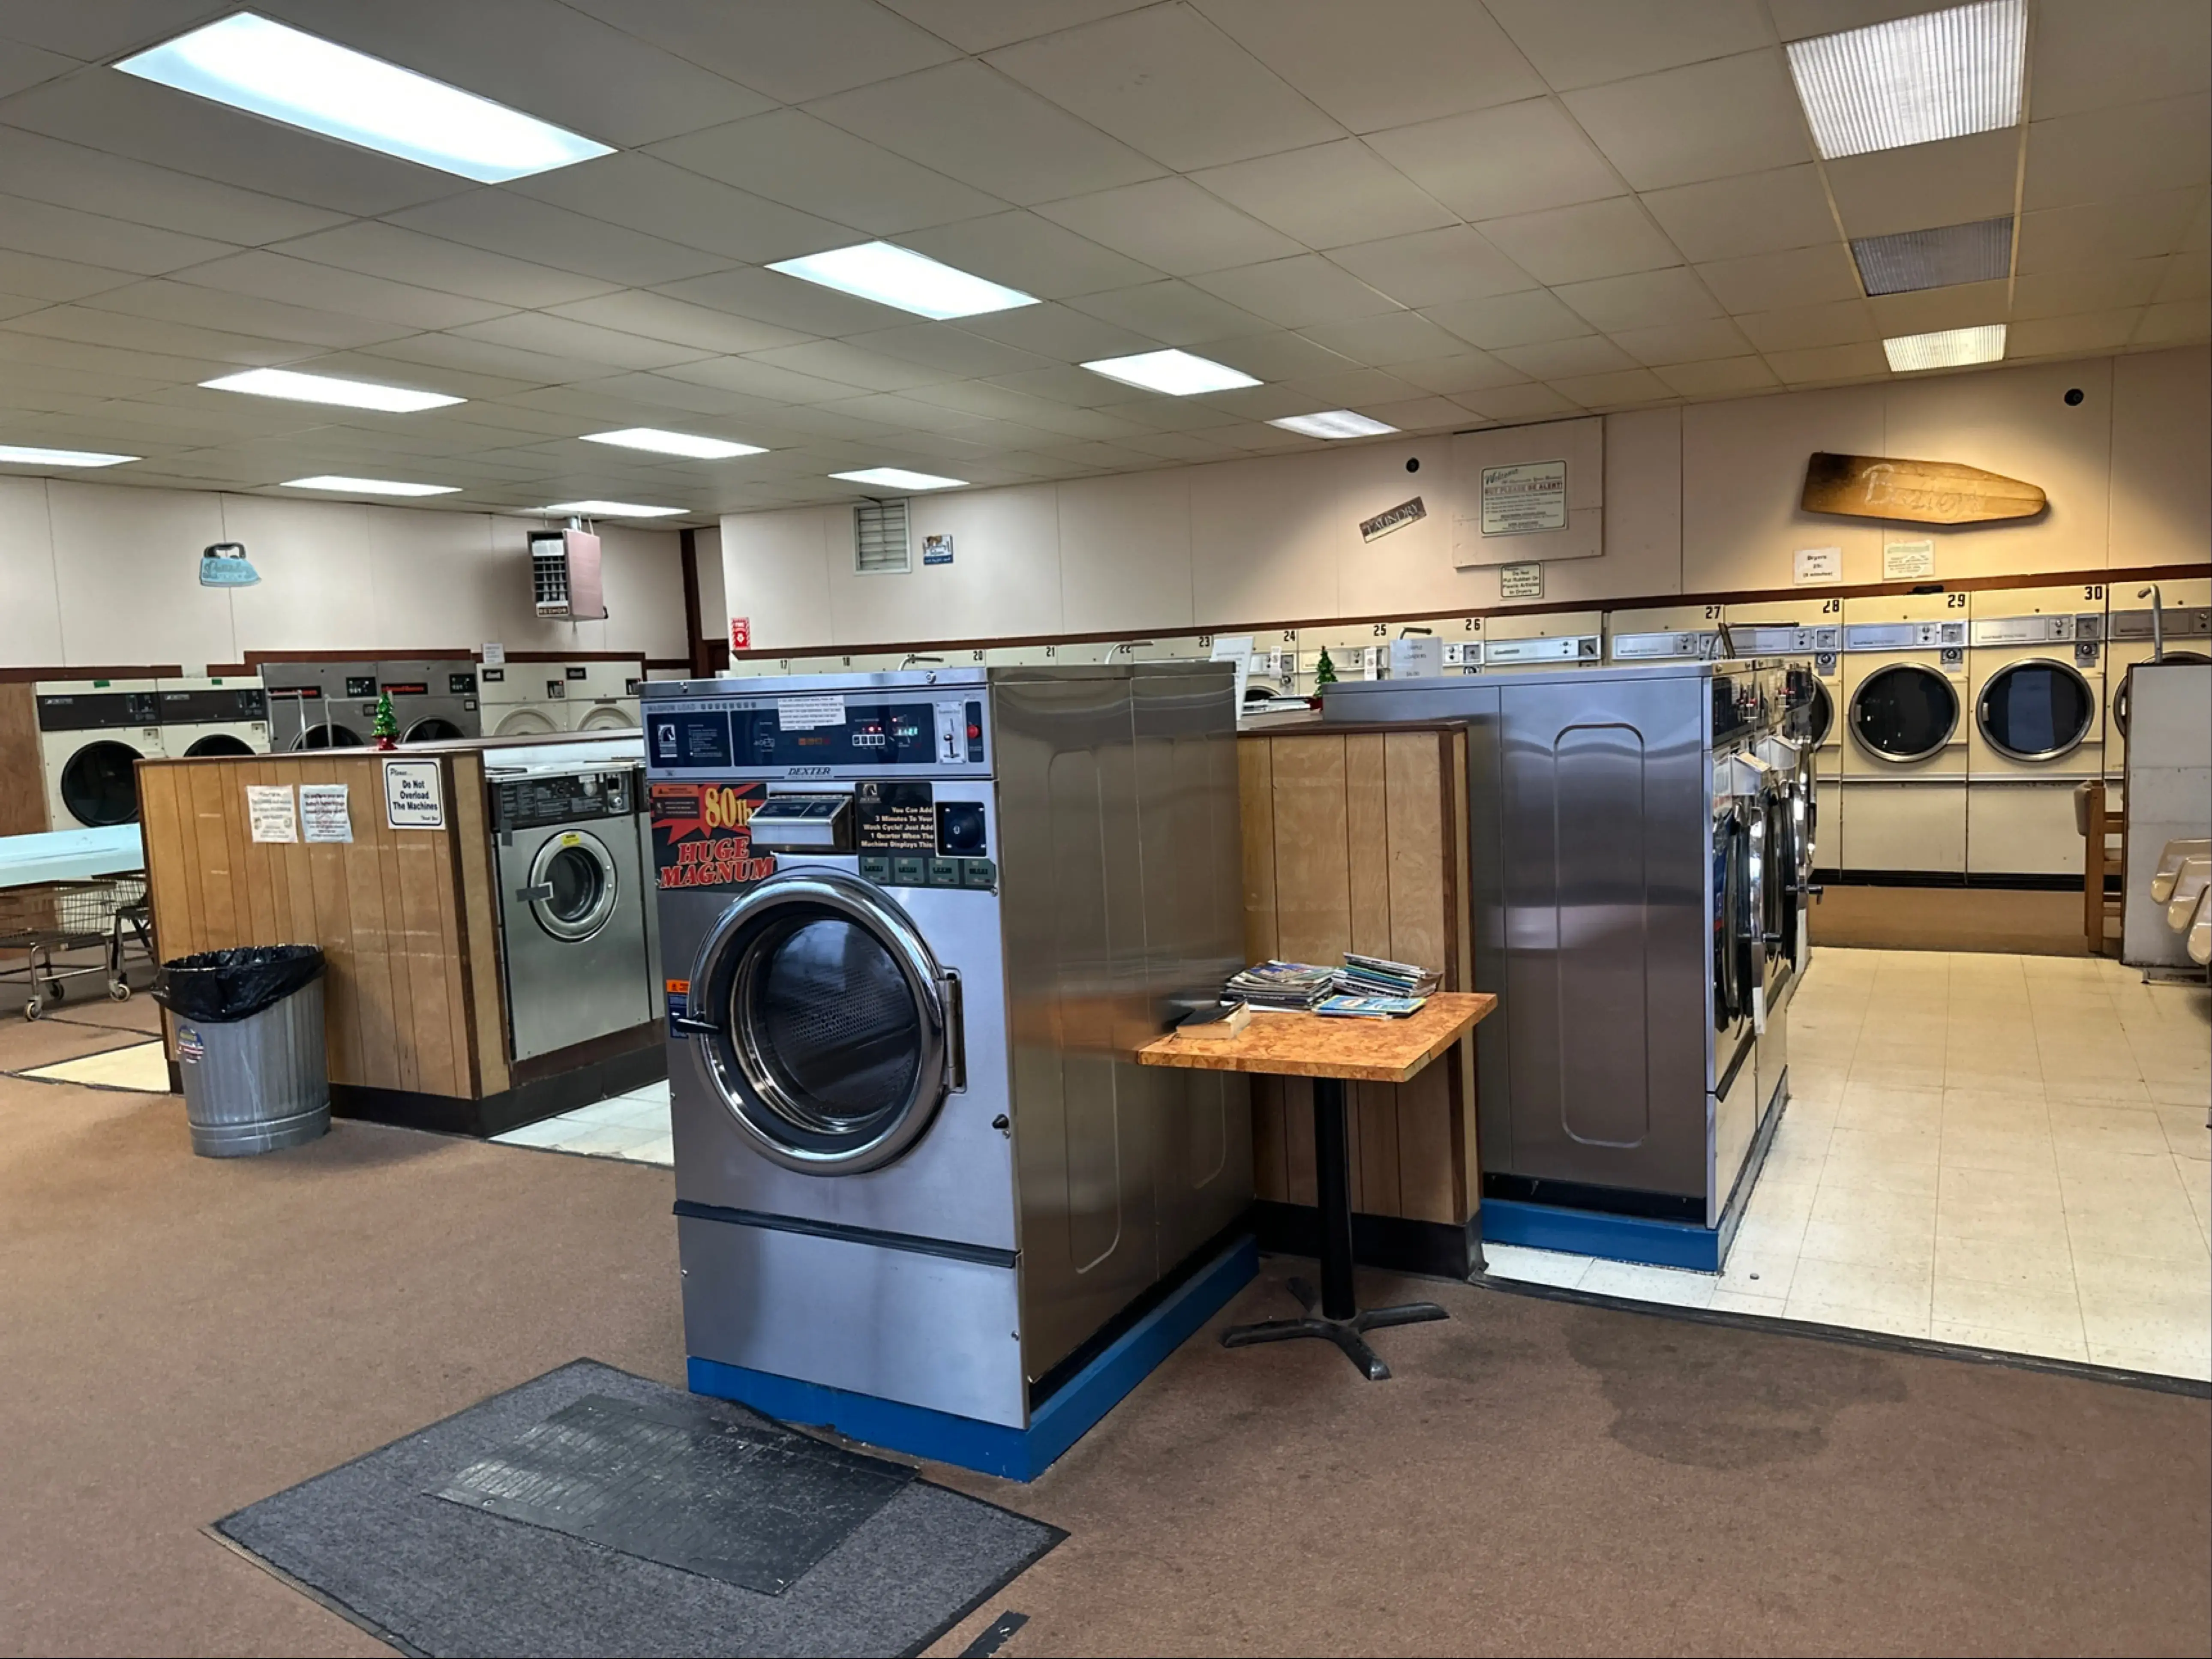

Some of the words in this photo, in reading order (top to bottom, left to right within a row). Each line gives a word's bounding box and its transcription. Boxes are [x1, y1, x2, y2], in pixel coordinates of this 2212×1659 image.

[1366, 504, 1418, 534] LAUNDRY
[2084, 585, 2103, 600] 30
[1822, 599, 1839, 613] 28
[1948, 594, 1965, 608] 29
[1706, 606, 1721, 620] 27
[1374, 624, 1387, 636] 25
[1465, 619, 1480, 630] 26
[1284, 630, 1295, 642] 24
[1199, 637, 1210, 648] 23
[973, 651, 982, 661] 20
[1046, 648, 1054, 657] 21
[780, 660, 787, 669] 17
[788, 767, 831, 775] DEXTER
[402, 780, 411, 788] Do
[413, 780, 425, 788] Not
[400, 790, 429, 799] Overload
[393, 801, 405, 810] The
[407, 801, 438, 810] Machines
[678, 836, 750, 865] HUGE
[660, 857, 775, 889] MAGNUM
